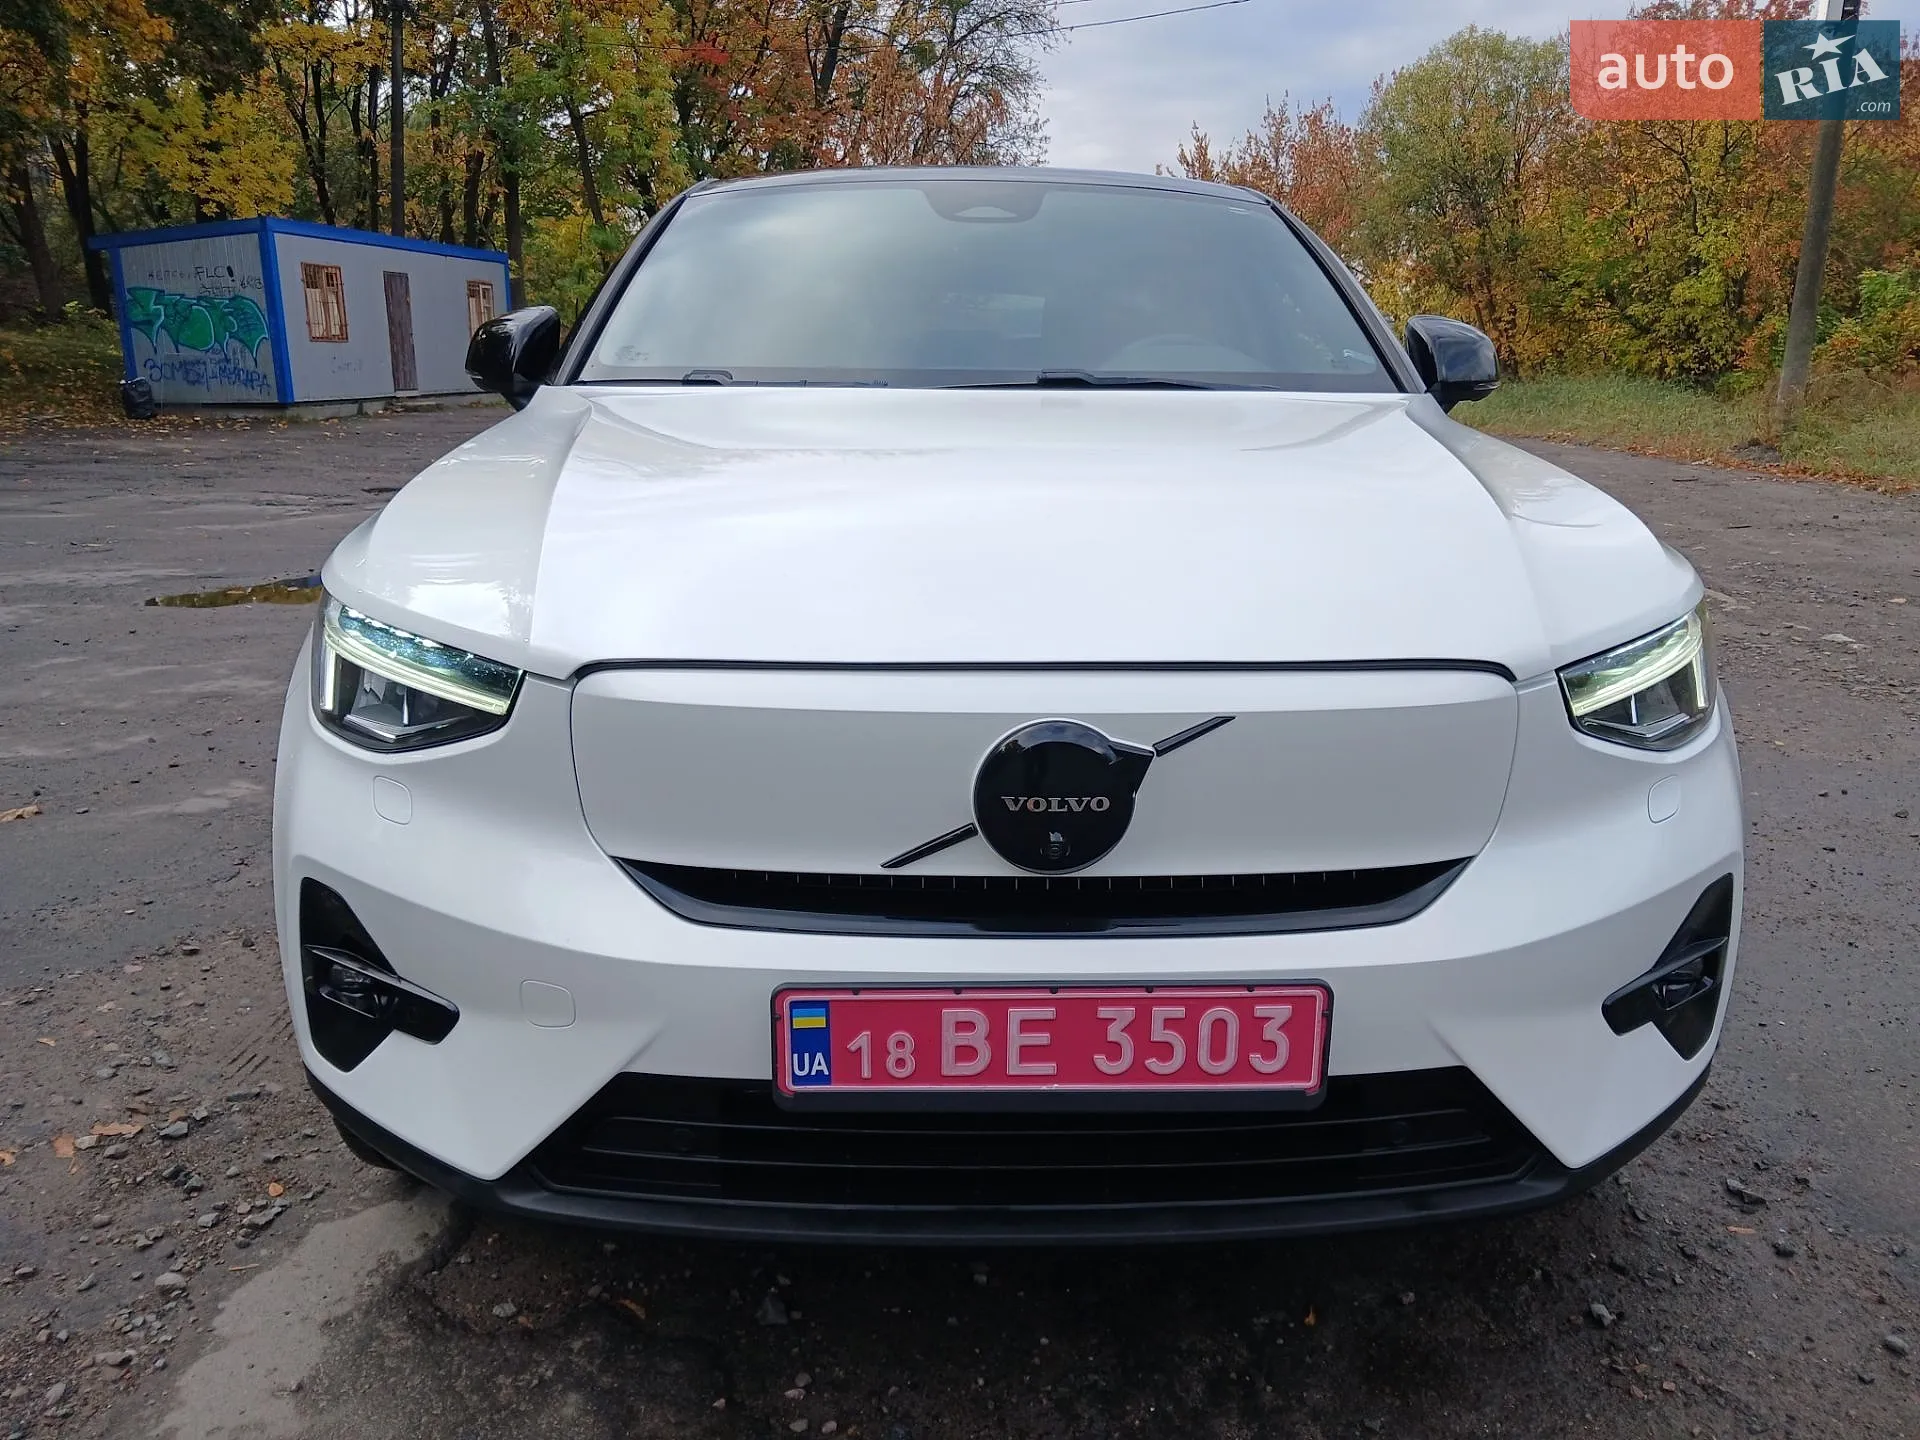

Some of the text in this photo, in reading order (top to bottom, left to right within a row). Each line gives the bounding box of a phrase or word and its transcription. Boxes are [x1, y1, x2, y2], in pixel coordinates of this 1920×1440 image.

[1000, 796, 1111, 812] VOLVO
[846, 1005, 1292, 1079] 18 BE 3503
[793, 1055, 829, 1077] UA
